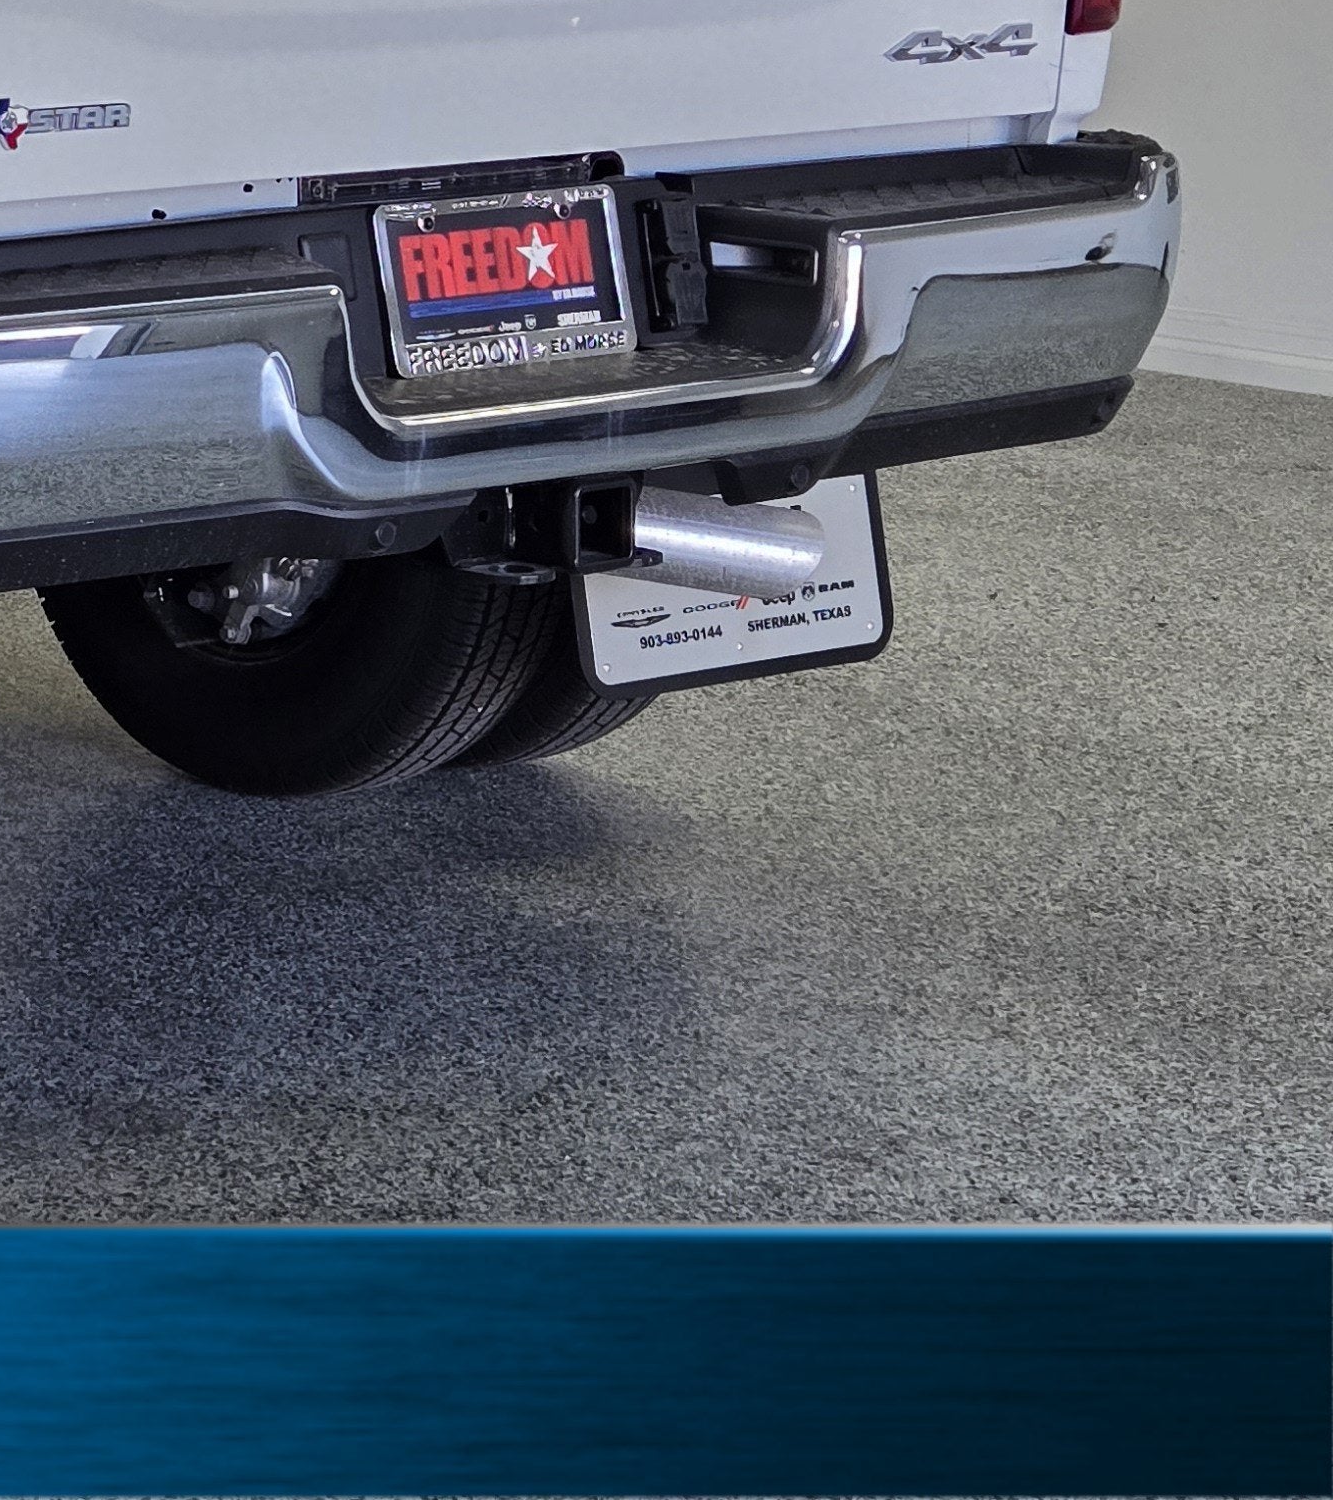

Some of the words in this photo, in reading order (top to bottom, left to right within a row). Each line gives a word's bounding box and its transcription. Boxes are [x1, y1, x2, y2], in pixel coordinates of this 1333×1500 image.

[25, 103, 130, 134] STAR
[398, 218, 595, 301] FREEDOM
[640, 624, 723, 649] 903-893-0144
[748, 612, 810, 632] SHERMAN,
[812, 605, 852, 621] TEXAS
